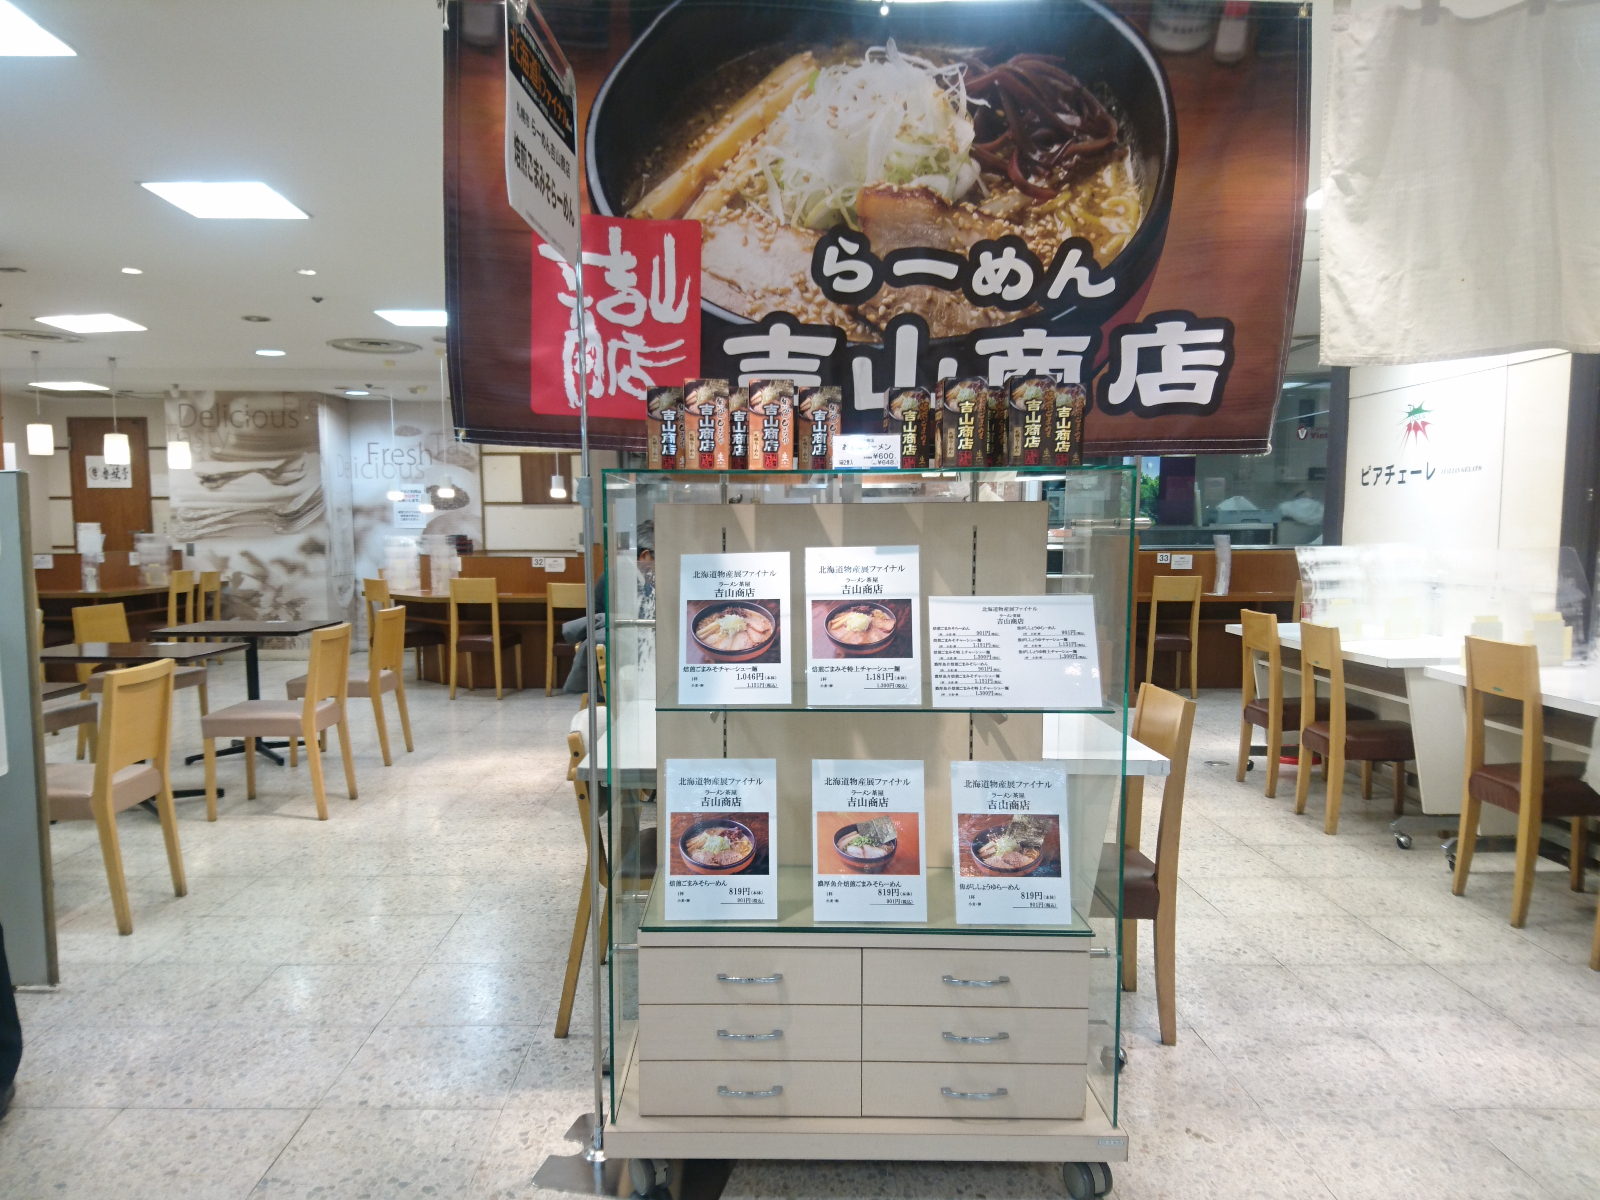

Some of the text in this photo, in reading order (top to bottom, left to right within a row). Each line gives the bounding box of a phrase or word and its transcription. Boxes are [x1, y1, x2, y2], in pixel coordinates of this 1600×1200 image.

[823, 236, 1116, 302] らーめん
[178, 403, 300, 429] Delicious
[698, 404, 715, 453] 吉山商店
[763, 404, 780, 453] 吉山商店
[957, 401, 976, 450] 吉山商店
[1024, 399, 1043, 449] 吉山商店
[661, 409, 677, 456] 吉山商店
[811, 409, 828, 457] 吉山商店
[902, 410, 918, 456] 吉山商店
[1055, 406, 1073, 453] 吉山商店
[367, 441, 433, 466] Fresh
[1361, 462, 1436, 487] ピアチェーレ
[818, 565, 905, 574] 北海道物産展ファイナル
[1159, 554, 1169, 562] 33
[693, 570, 777, 579] 北海道物産展ファイナル
[714, 588, 756, 598] 吉山商店
[841, 584, 883, 595] 吉山商店
[679, 777, 764, 786] 北海道物産展ファイナル
[824, 777, 911, 786] 北海道物産展ファイナル
[964, 780, 1052, 789] 北海道物産展ファイナル
[700, 796, 742, 807] 吉山商店
[847, 797, 889, 808] 吉山商店
[987, 800, 1030, 811] 吉山商店
